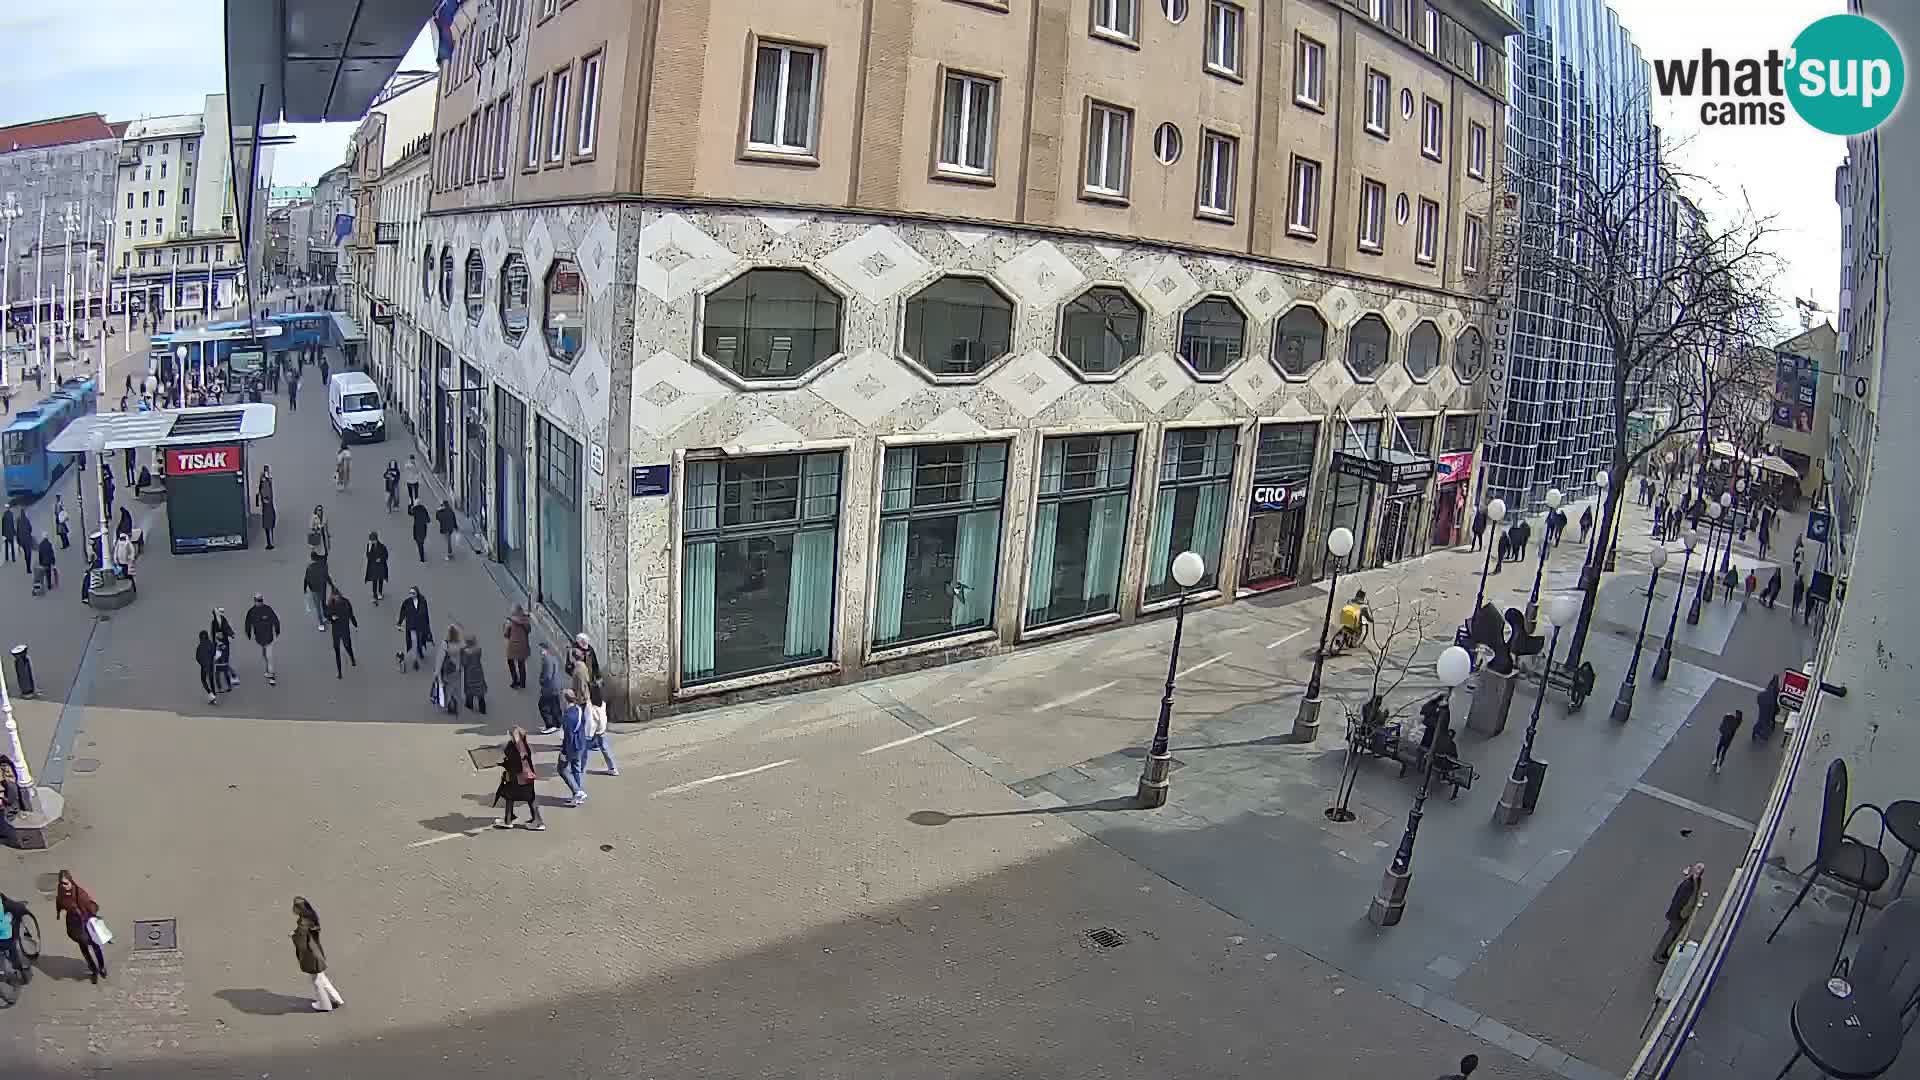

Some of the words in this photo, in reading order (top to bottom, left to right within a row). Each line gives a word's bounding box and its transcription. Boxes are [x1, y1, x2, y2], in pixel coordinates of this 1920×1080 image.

[1484, 308, 1510, 442] DUBROVNIK
[178, 452, 228, 470] TISAK
[1255, 487, 1286, 503] CRO
